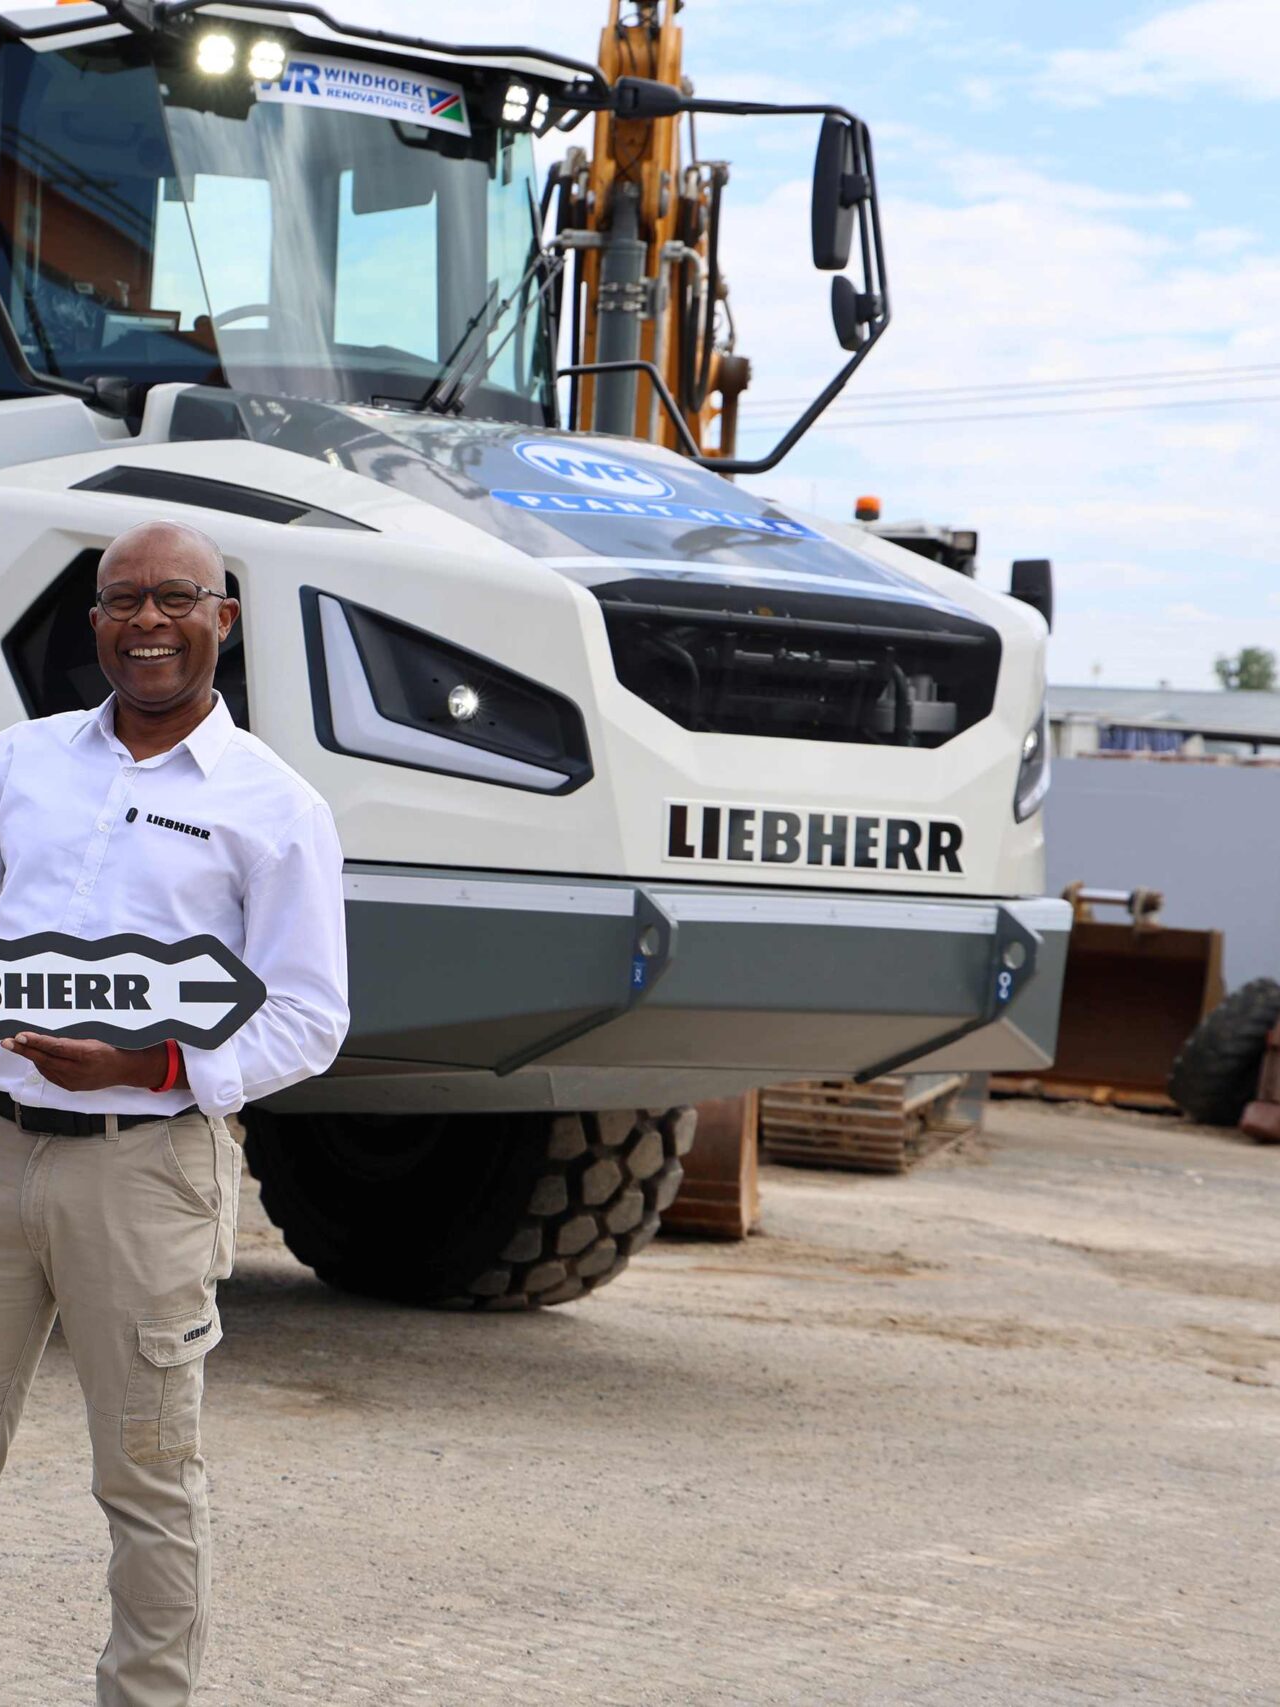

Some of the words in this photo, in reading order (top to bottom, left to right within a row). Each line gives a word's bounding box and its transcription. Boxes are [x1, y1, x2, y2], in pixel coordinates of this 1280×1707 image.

[323, 67, 424, 98] WINDHOEK
[326, 87, 409, 113] RENOVATIONS
[411, 103, 426, 115] CC
[529, 455, 658, 485] WR
[517, 493, 674, 517] PLANT
[689, 507, 805, 535] HIRE
[146, 813, 210, 840] LIEBHERR
[668, 804, 964, 873] LIEBHERR
